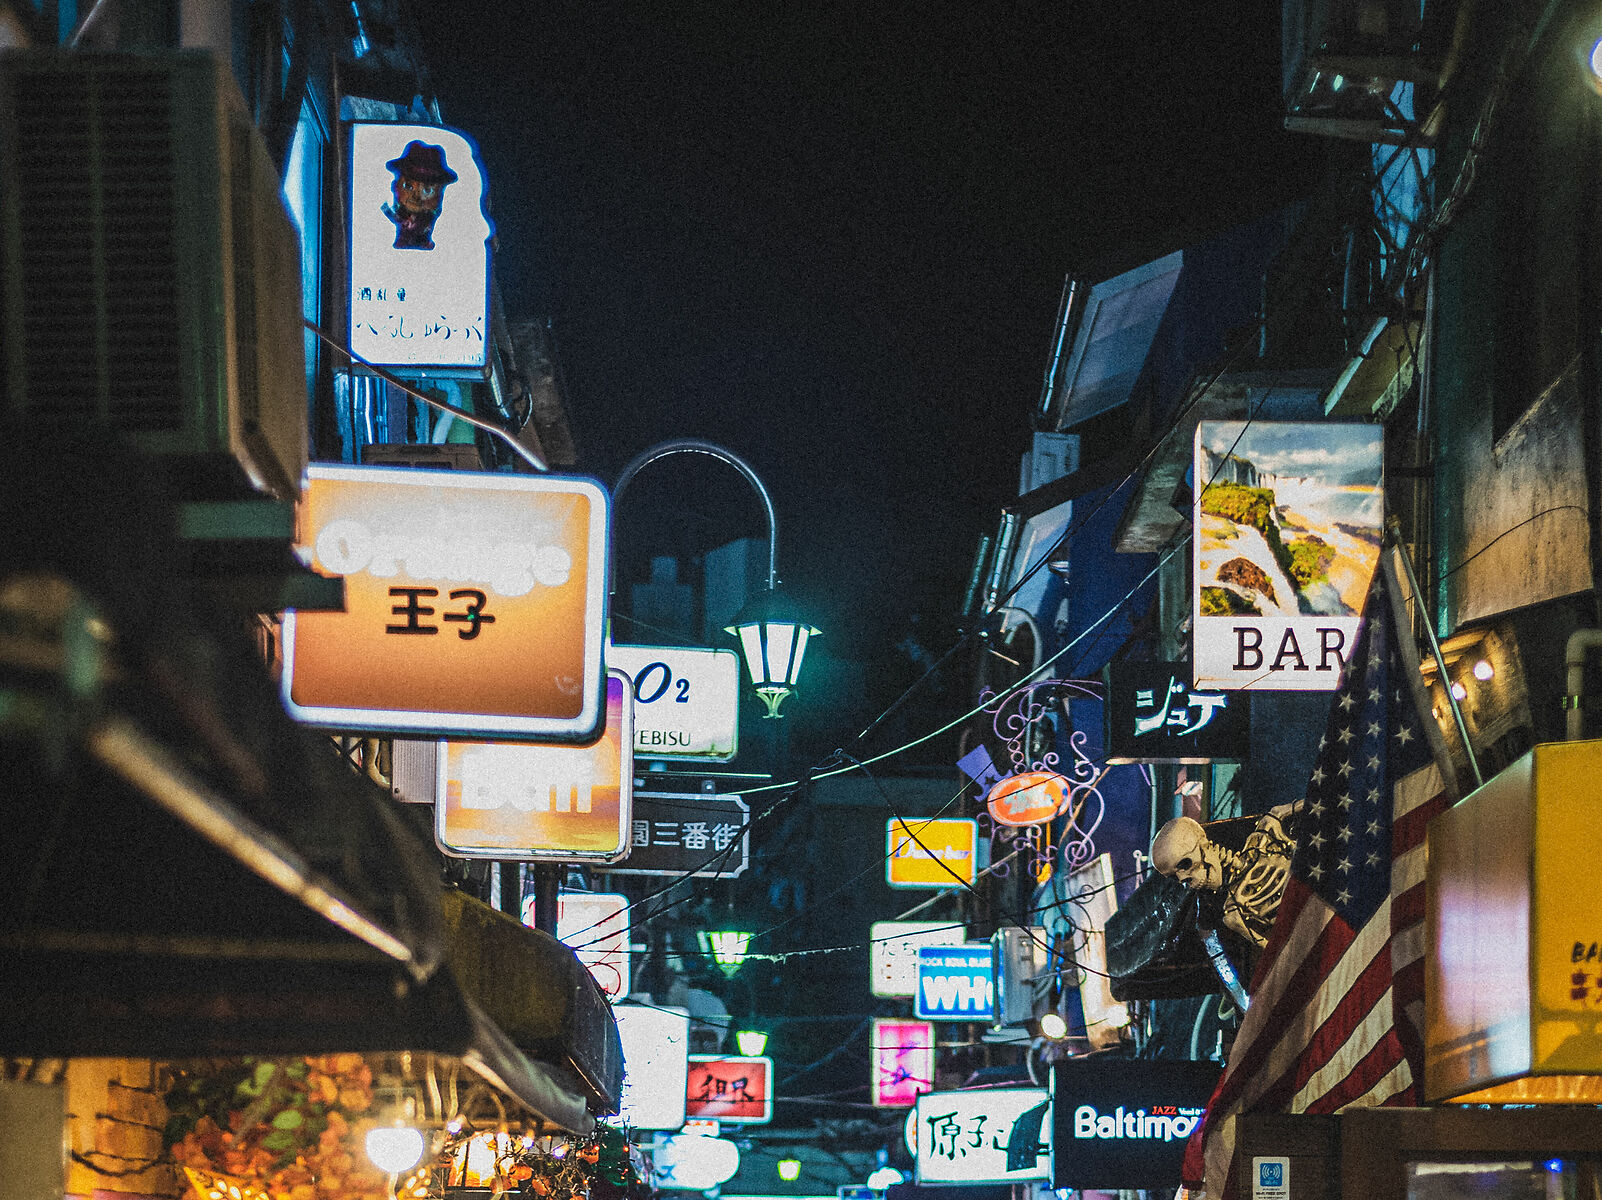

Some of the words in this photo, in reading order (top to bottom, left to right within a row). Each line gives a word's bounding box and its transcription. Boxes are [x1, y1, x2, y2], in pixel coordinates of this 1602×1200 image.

[385, 587, 496, 640] 王子
[1232, 626, 1347, 673] BAR
[1134, 675, 1227, 737] ジュテ
[1152, 1106, 1177, 1115] JAZZ
